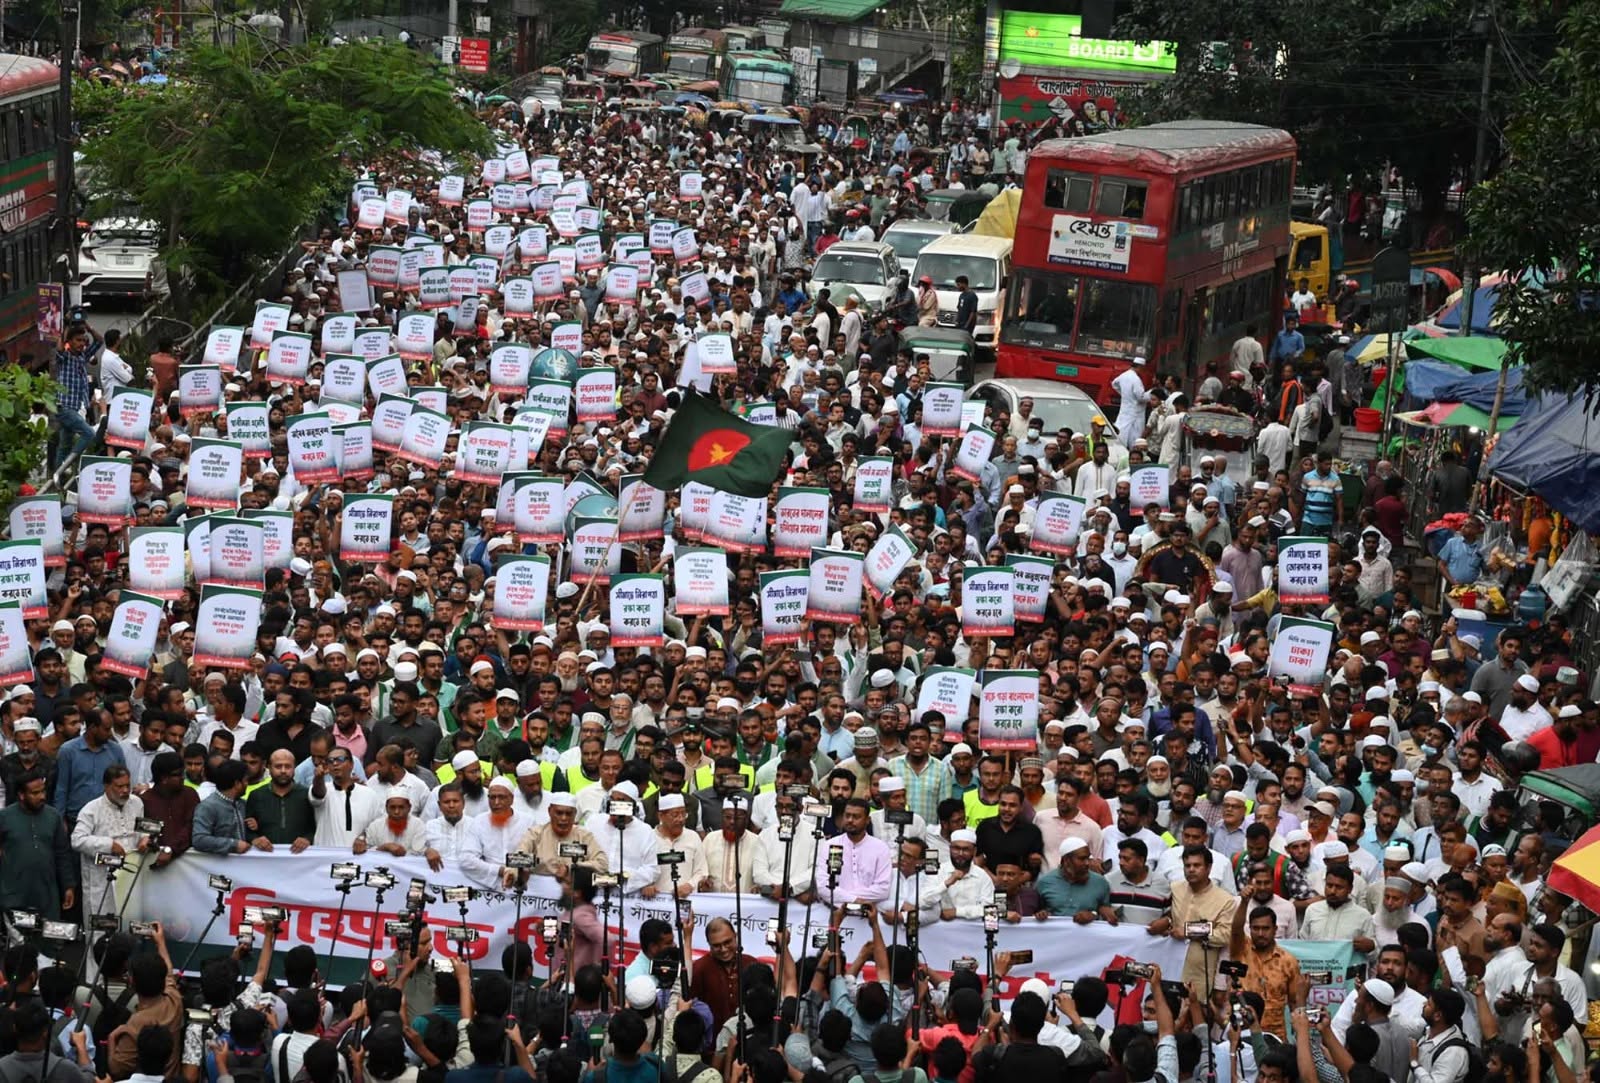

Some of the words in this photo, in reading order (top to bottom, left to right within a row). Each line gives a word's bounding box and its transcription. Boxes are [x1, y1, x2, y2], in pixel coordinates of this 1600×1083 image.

[1068, 43, 1129, 59] BOARD
[1069, 220, 1115, 239] হেমন্ত
[1074, 240, 1104, 249] HEMONTO
[1373, 281, 1407, 299] JUSTICE
[348, 507, 366, 519] সীমান্তে
[366, 507, 387, 519] নিরাপত্তা
[354, 522, 366, 531] রক্ষা
[367, 522, 380, 532] করো
[353, 534, 369, 544] করতে
[370, 534, 379, 543] হবে
[1287, 547, 1306, 560] সীমান্তে
[1306, 549, 1321, 559] প্রহরা
[12, 556, 37, 569] নিরাপত্তা
[1286, 562, 1311, 573] জোরদার
[1311, 563, 1323, 572] কর
[0, 574, 14, 585] রক্ষা
[15, 573, 30, 584] করো
[1013, 569, 1024, 579] বৈধ
[1024, 572, 1050, 583] অনুপ্রবেশ
[1289, 576, 1307, 586] করতে
[1307, 576, 1318, 585] হবে
[766, 586, 784, 598] সীমান্তে
[785, 585, 807, 597] নিরাপত্তা
[969, 580, 986, 592] সীমান্তে
[987, 580, 1009, 592] নিরাপত্তা
[1025, 583, 1039, 593] করো
[1, 589, 20, 600] করতে
[21, 588, 32, 599] হবে
[615, 587, 634, 600] সীমান্তে
[634, 588, 658, 600] নিরাপত্তা
[976, 595, 988, 605] রক্ষা
[988, 595, 1002, 606] করো
[623, 604, 635, 613] রক্ষা
[636, 604, 650, 614] করো
[774, 602, 787, 611] রক্ষা
[787, 601, 802, 612] করো
[976, 609, 992, 618] করতে
[992, 609, 1002, 618] হবে
[623, 617, 640, 627] করতে
[640, 617, 651, 627] হবে
[775, 615, 791, 625] করতে
[1290, 646, 1314, 658] ঢাকা!
[1288, 655, 1312, 668] ঢাকা!
[984, 692, 996, 702] রক্তে
[996, 692, 1008, 702] গড়া
[1008, 692, 1034, 703] বাংলাদেশ
[994, 705, 1008, 715] রক্ষা
[1008, 705, 1022, 716] করো
[994, 719, 1011, 729] করতে
[1011, 719, 1023, 729] হবে
